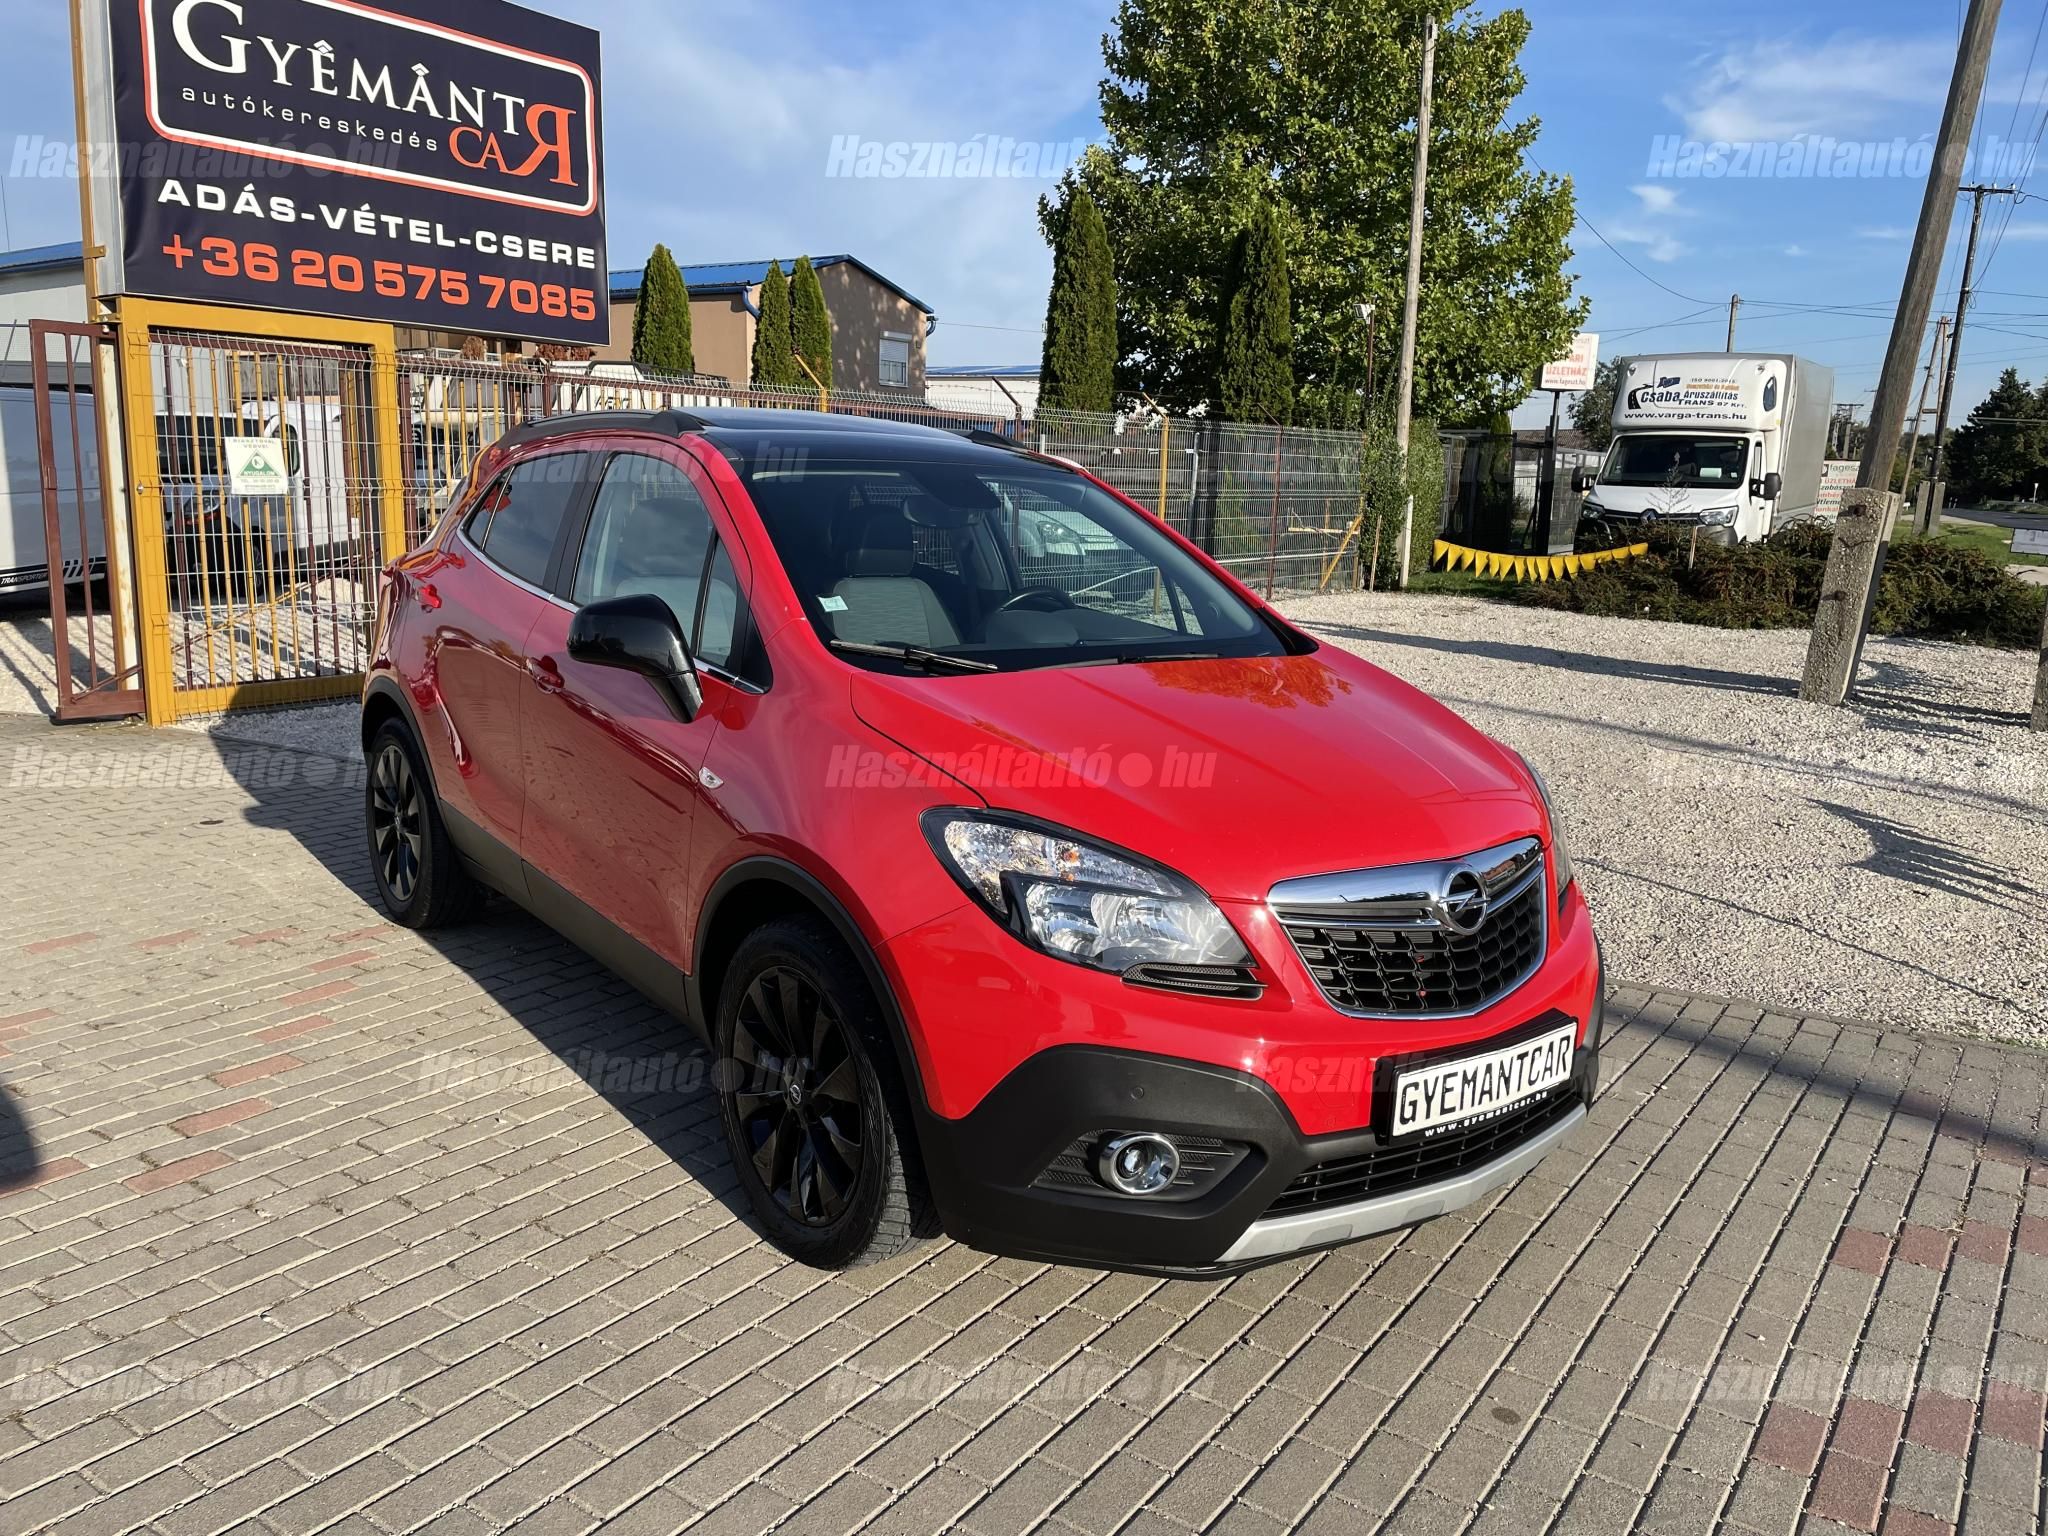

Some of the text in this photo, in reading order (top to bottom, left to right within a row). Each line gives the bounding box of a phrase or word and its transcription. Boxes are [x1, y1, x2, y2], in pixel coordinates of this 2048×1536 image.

[181, 85, 438, 152] autókereskedés
[157, 178, 596, 269] ADÁS-VÉTEL-CSERE
[162, 234, 596, 322] +36 20 575 7085
[1624, 412, 1747, 420] www.varga-trans.hu
[1640, 390, 1680, 403] Csaba
[1400, 1035, 1571, 1125] GYEMANTCAR
[1425, 1091, 1548, 1137] www.gyemantcar.hu
